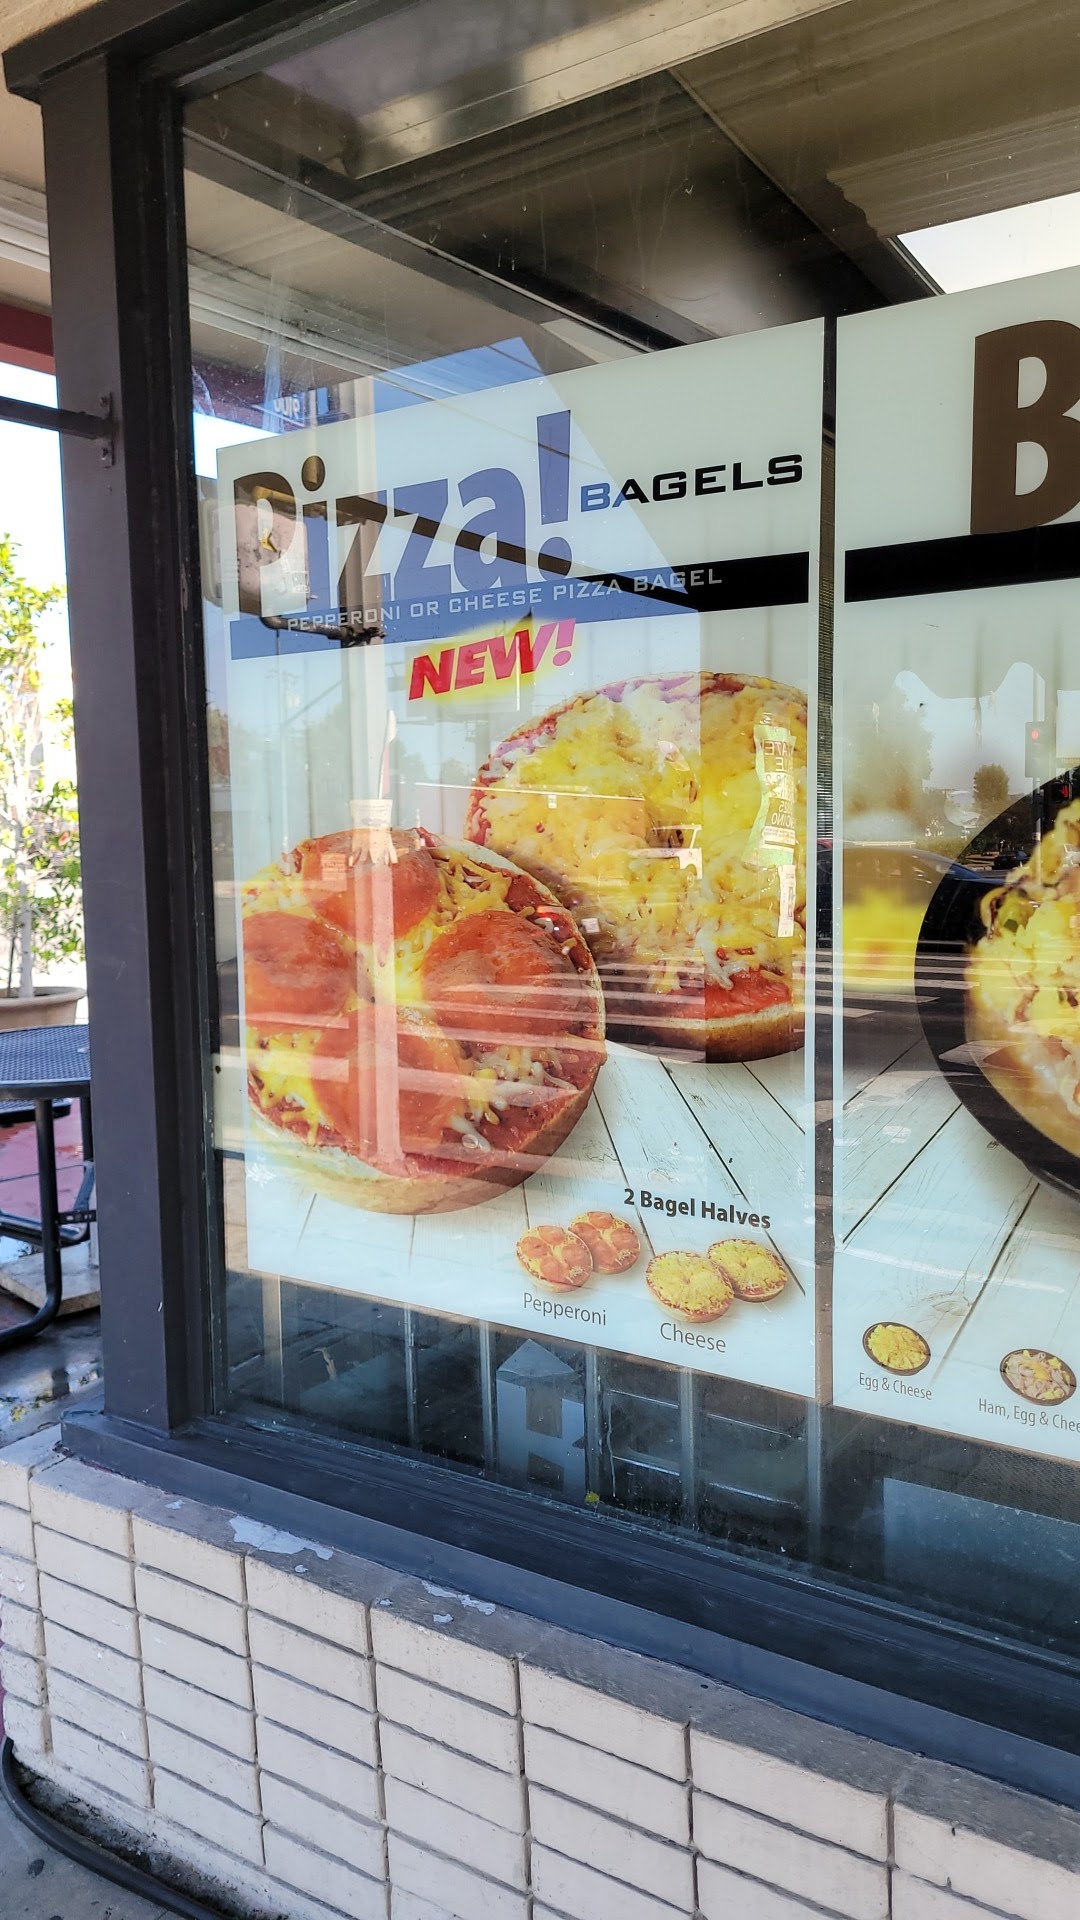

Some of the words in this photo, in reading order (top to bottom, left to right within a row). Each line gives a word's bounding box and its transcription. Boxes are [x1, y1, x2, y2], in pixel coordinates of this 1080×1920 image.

[580, 454, 803, 513] BAGELS
[233, 410, 573, 617] Pizza!
[287, 604, 400, 632] PEPPERONI
[410, 602, 440, 618] OR
[449, 587, 543, 614] CHEESE
[553, 578, 623, 601] PIZZA
[634, 567, 723, 593] BAGEL
[408, 618, 576, 701] NEW!
[623, 1188, 635, 1206] 2
[640, 1190, 696, 1218] Bagel
[701, 1200, 771, 1230] Halves
[523, 1292, 607, 1326] Pepperoni
[660, 1322, 727, 1353] Cheese
[859, 1372, 879, 1392] Egg
[881, 1378, 891, 1391] &
[893, 1379, 933, 1400] Cheese
[978, 1398, 1010, 1420] Ham,
[1013, 1405, 1036, 1427] Egg
[1039, 1411, 1049, 1426] &
